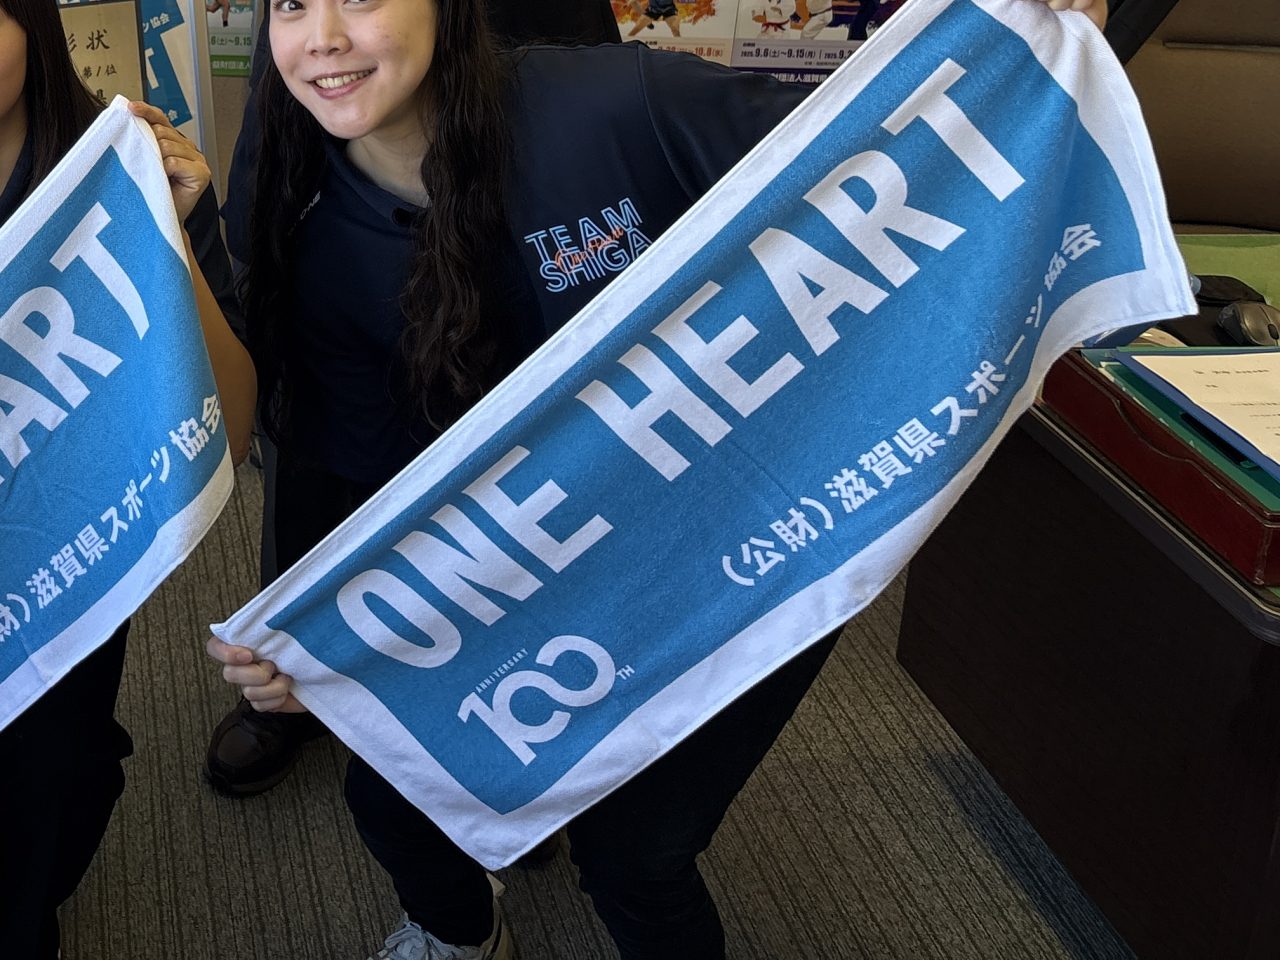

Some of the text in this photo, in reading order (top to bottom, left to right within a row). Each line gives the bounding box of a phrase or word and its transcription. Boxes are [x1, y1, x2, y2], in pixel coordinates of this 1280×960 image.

[524, 197, 643, 263] TEAM
[539, 227, 653, 293] SHIGA
[337, 58, 1024, 668] ONE HEART
[723, 224, 1101, 586] (公財)滋賀県スポーツ協会
[475, 647, 529, 694] ANNIVERSARY
